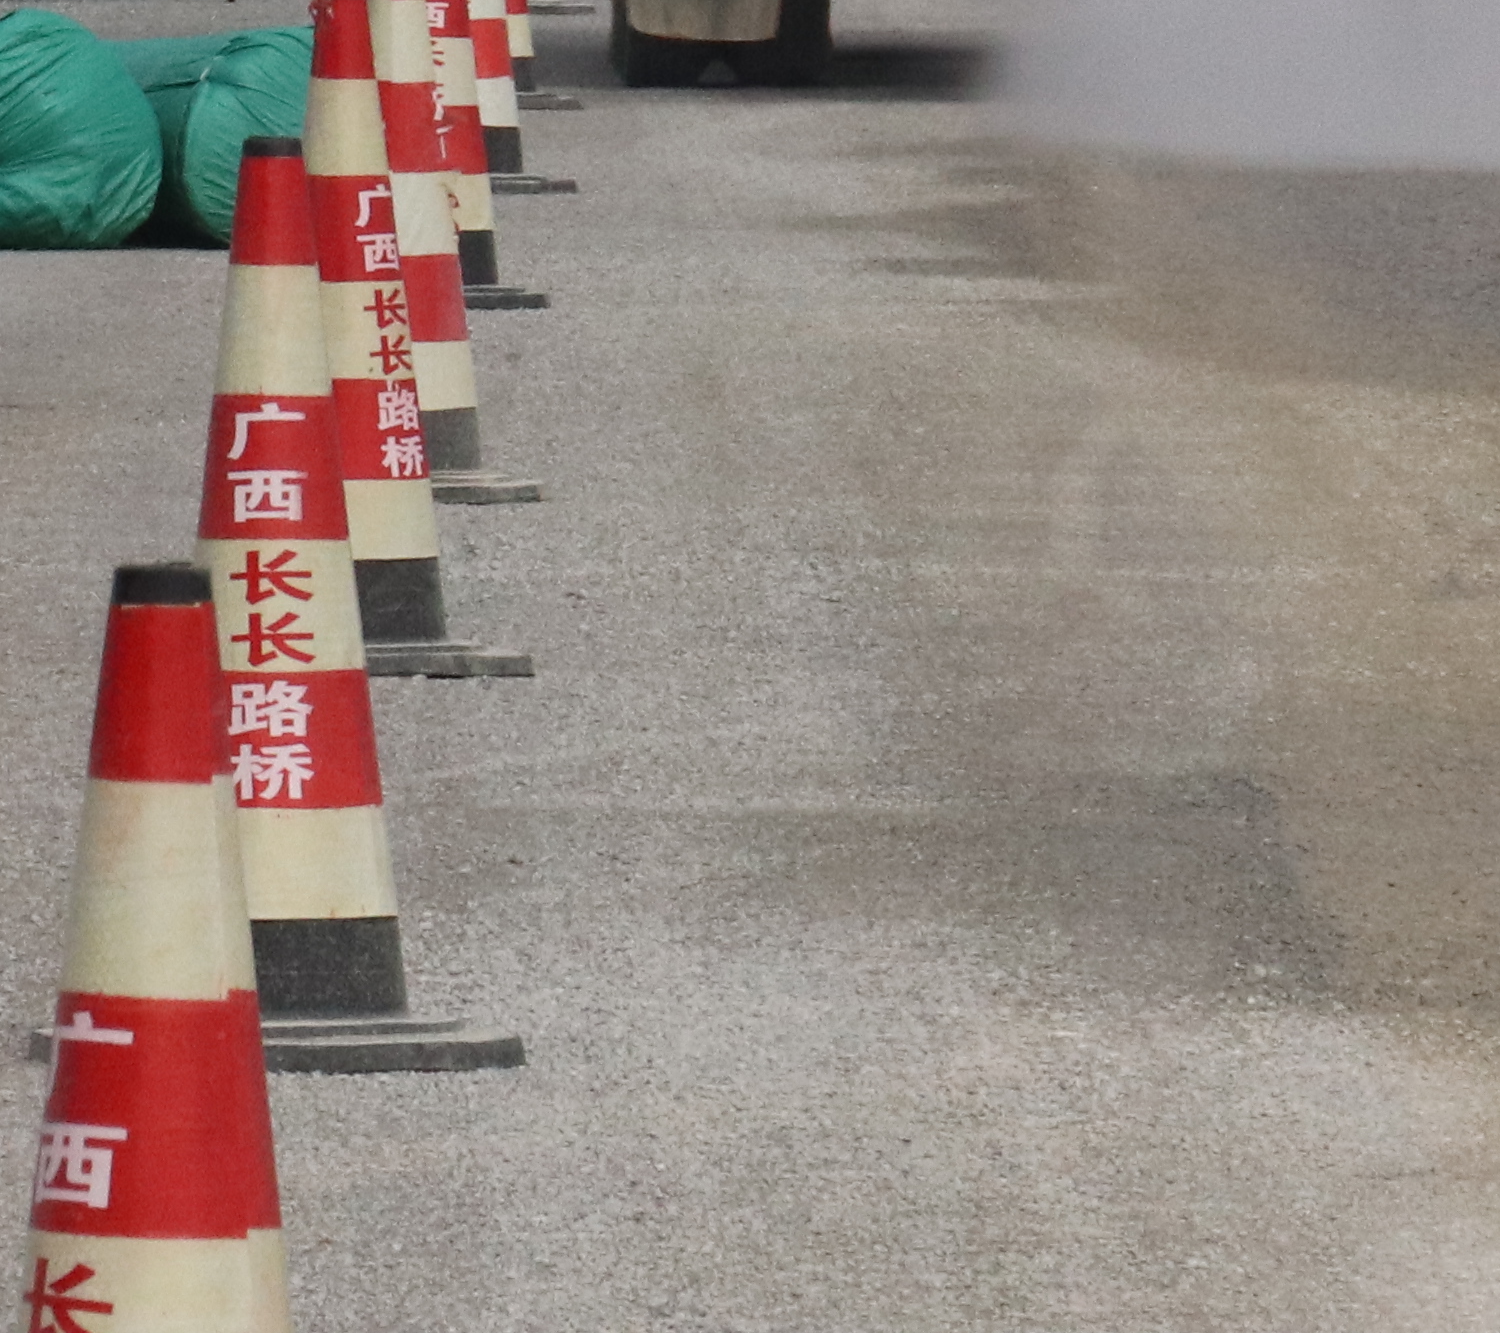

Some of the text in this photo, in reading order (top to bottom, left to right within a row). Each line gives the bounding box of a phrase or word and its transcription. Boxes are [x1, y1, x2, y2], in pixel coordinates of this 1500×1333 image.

[354, 183, 424, 479] 广西长长路桥
[226, 401, 317, 802] 广西长长路桥
